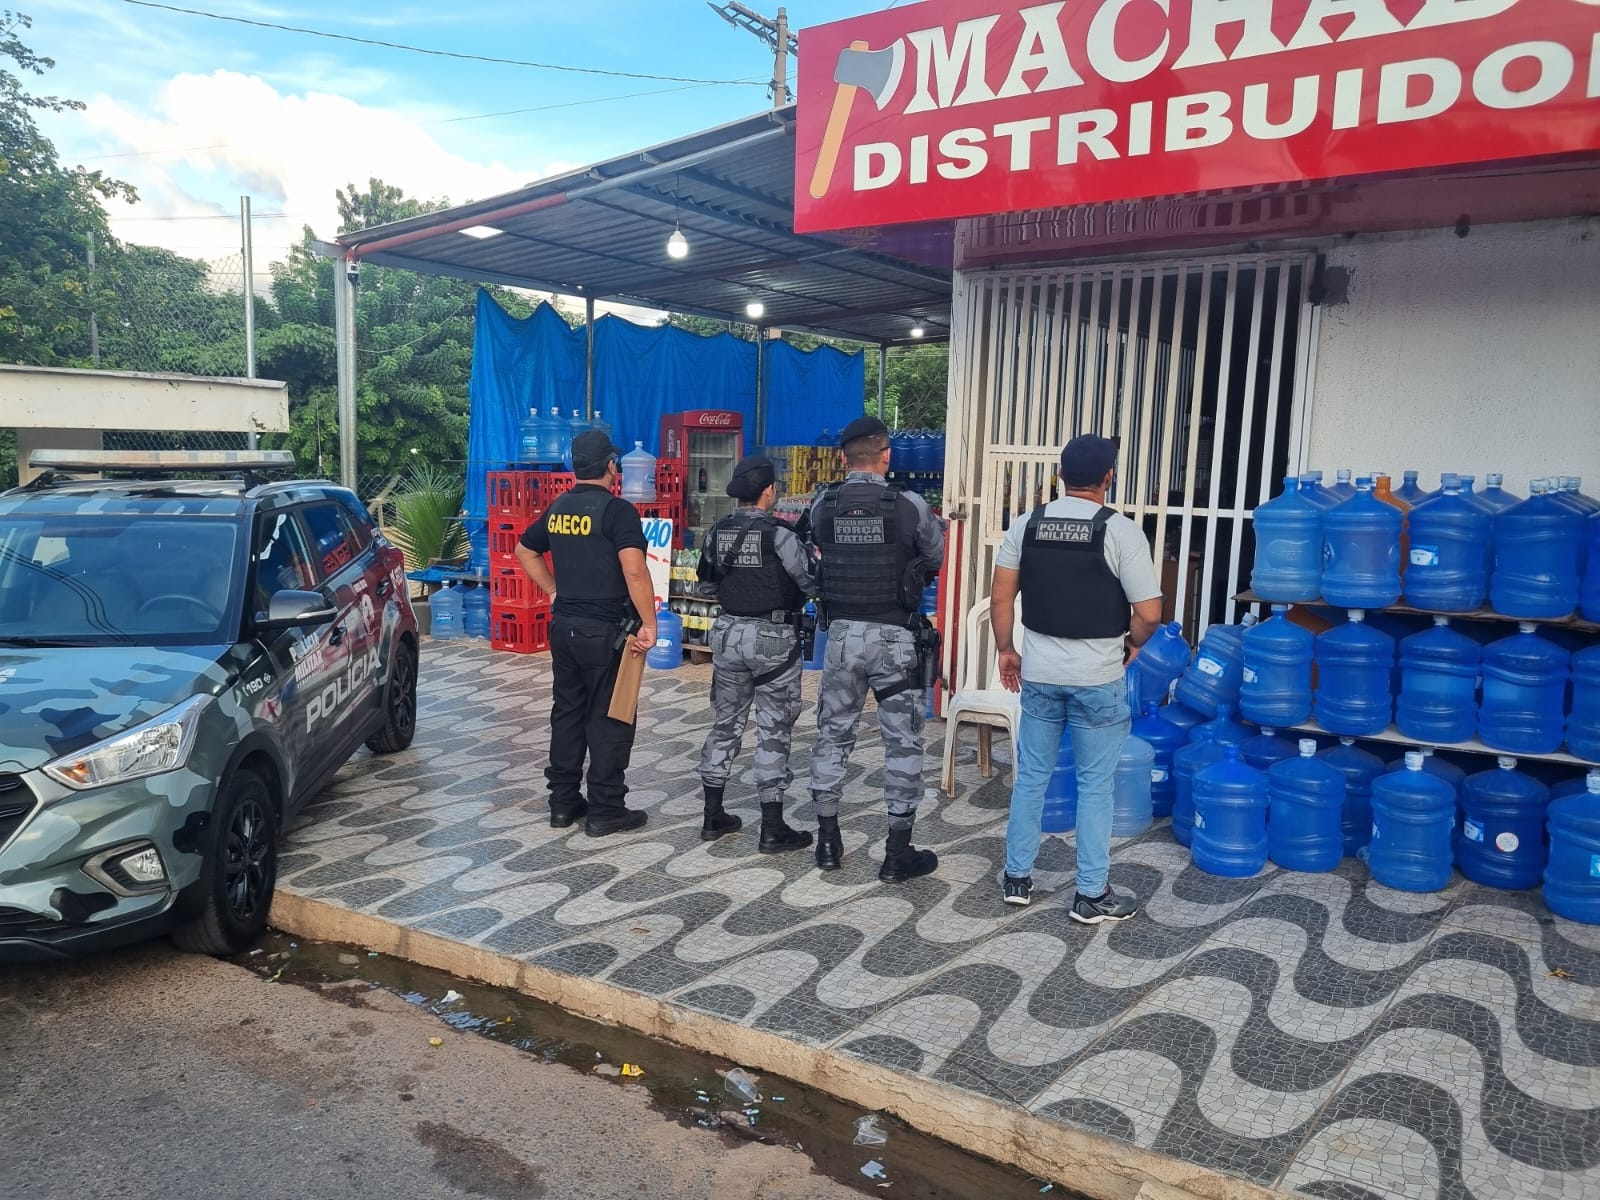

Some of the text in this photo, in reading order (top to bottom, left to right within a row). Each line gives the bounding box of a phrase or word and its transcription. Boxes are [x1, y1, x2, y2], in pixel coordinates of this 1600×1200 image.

[903, 0, 1600, 114] MACH
[547, 514, 591, 535] GAECO
[836, 526, 882, 535] FORÇA
[1040, 522, 1089, 532] POLÍCIA
[1038, 531, 1089, 540] MILITAR
[719, 542, 758, 554] FOÇA
[719, 554, 760, 564] TICA
[295, 650, 323, 682] MILITAR
[306, 645, 382, 734] POLÍCIA
